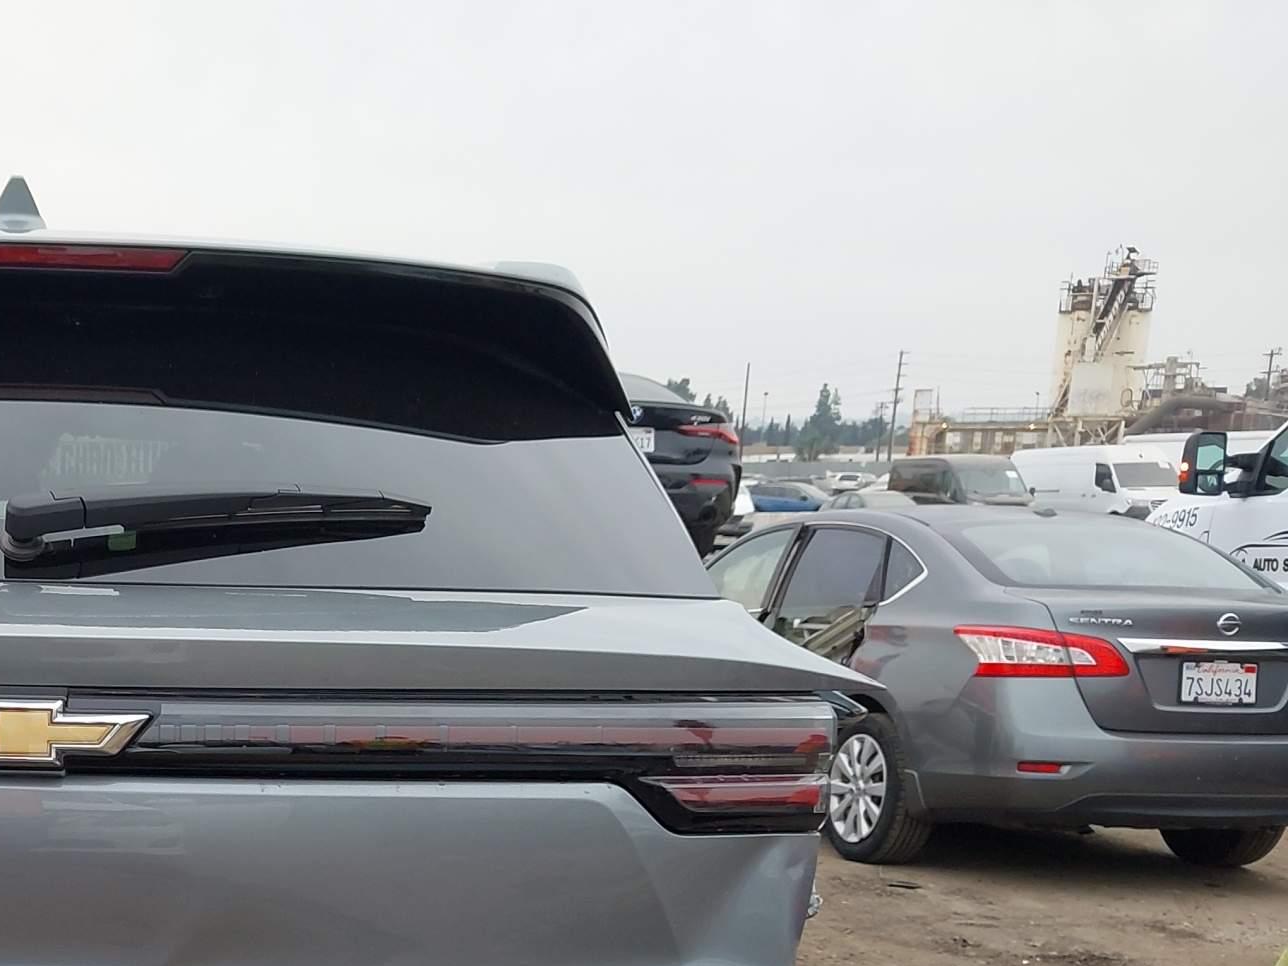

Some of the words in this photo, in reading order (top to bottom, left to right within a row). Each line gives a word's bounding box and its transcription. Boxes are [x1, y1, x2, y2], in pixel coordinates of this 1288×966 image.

[1253, 558, 1279, 572] AUTO
[1069, 617, 1133, 625] SENTRA
[1186, 676, 1252, 698] 7SJS434
